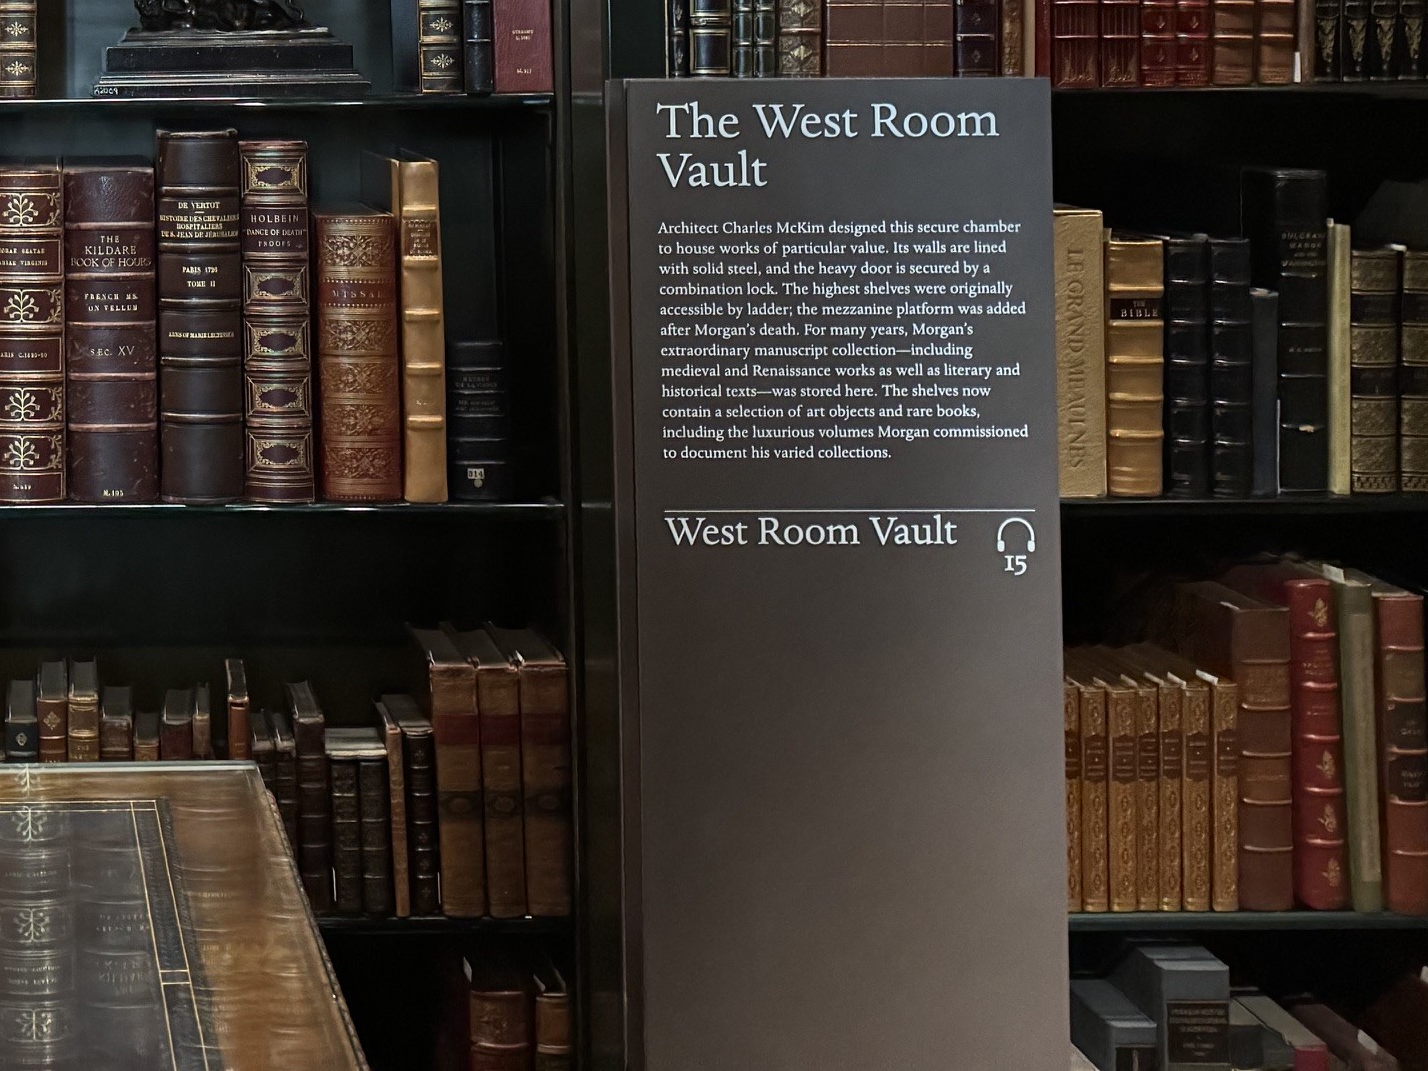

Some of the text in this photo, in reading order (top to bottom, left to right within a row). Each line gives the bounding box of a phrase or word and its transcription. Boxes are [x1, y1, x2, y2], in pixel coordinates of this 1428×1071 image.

[656, 100, 1000, 139] The West Room
[655, 149, 768, 188] Vault
[191, 201, 220, 210] VERTOT
[250, 214, 299, 223] HOLBEIN
[270, 228, 280, 236] OF
[657, 219, 1022, 238] Architect Charles McKim designed this secure chamber
[100, 235, 120, 243] THE
[658, 239, 1007, 258] to house works of particular value. Its walls are lined
[84, 246, 137, 255] KILDARE
[101, 257, 116, 268] OF
[658, 259, 991, 279] with solid steel, and the heavy door is secured by a
[187, 280, 216, 288] TOME II
[659, 280, 1014, 299] combination lock. The highest shelves were originally
[659, 299, 1027, 320] accessible by ladder; the mezzanine platform was added
[1066, 284, 1085, 353] GRAND
[1121, 308, 1159, 317] BIBLE
[660, 321, 974, 340] after Morgan’s death. For many years, Morgan’s
[117, 345, 135, 356] XV
[660, 342, 751, 360] extraordinary
[754, 343, 829, 360] manuscript
[661, 361, 1021, 380] medieval and Renaissance works as well as literary and
[661, 383, 722, 398] historical
[800, 383, 842, 398] stored
[844, 383, 878, 397] here.
[881, 383, 909, 397] The
[911, 382, 960, 397] shelves
[961, 386, 992, 397] now
[662, 402, 981, 421] contain a selection of art objects and rare books,
[662, 423, 1029, 443] including the luxurious volumes Morgan commissioned
[663, 444, 892, 459] to document his varied collections.
[663, 514, 958, 546] West Room Vault
[1003, 554, 1028, 576] 15
